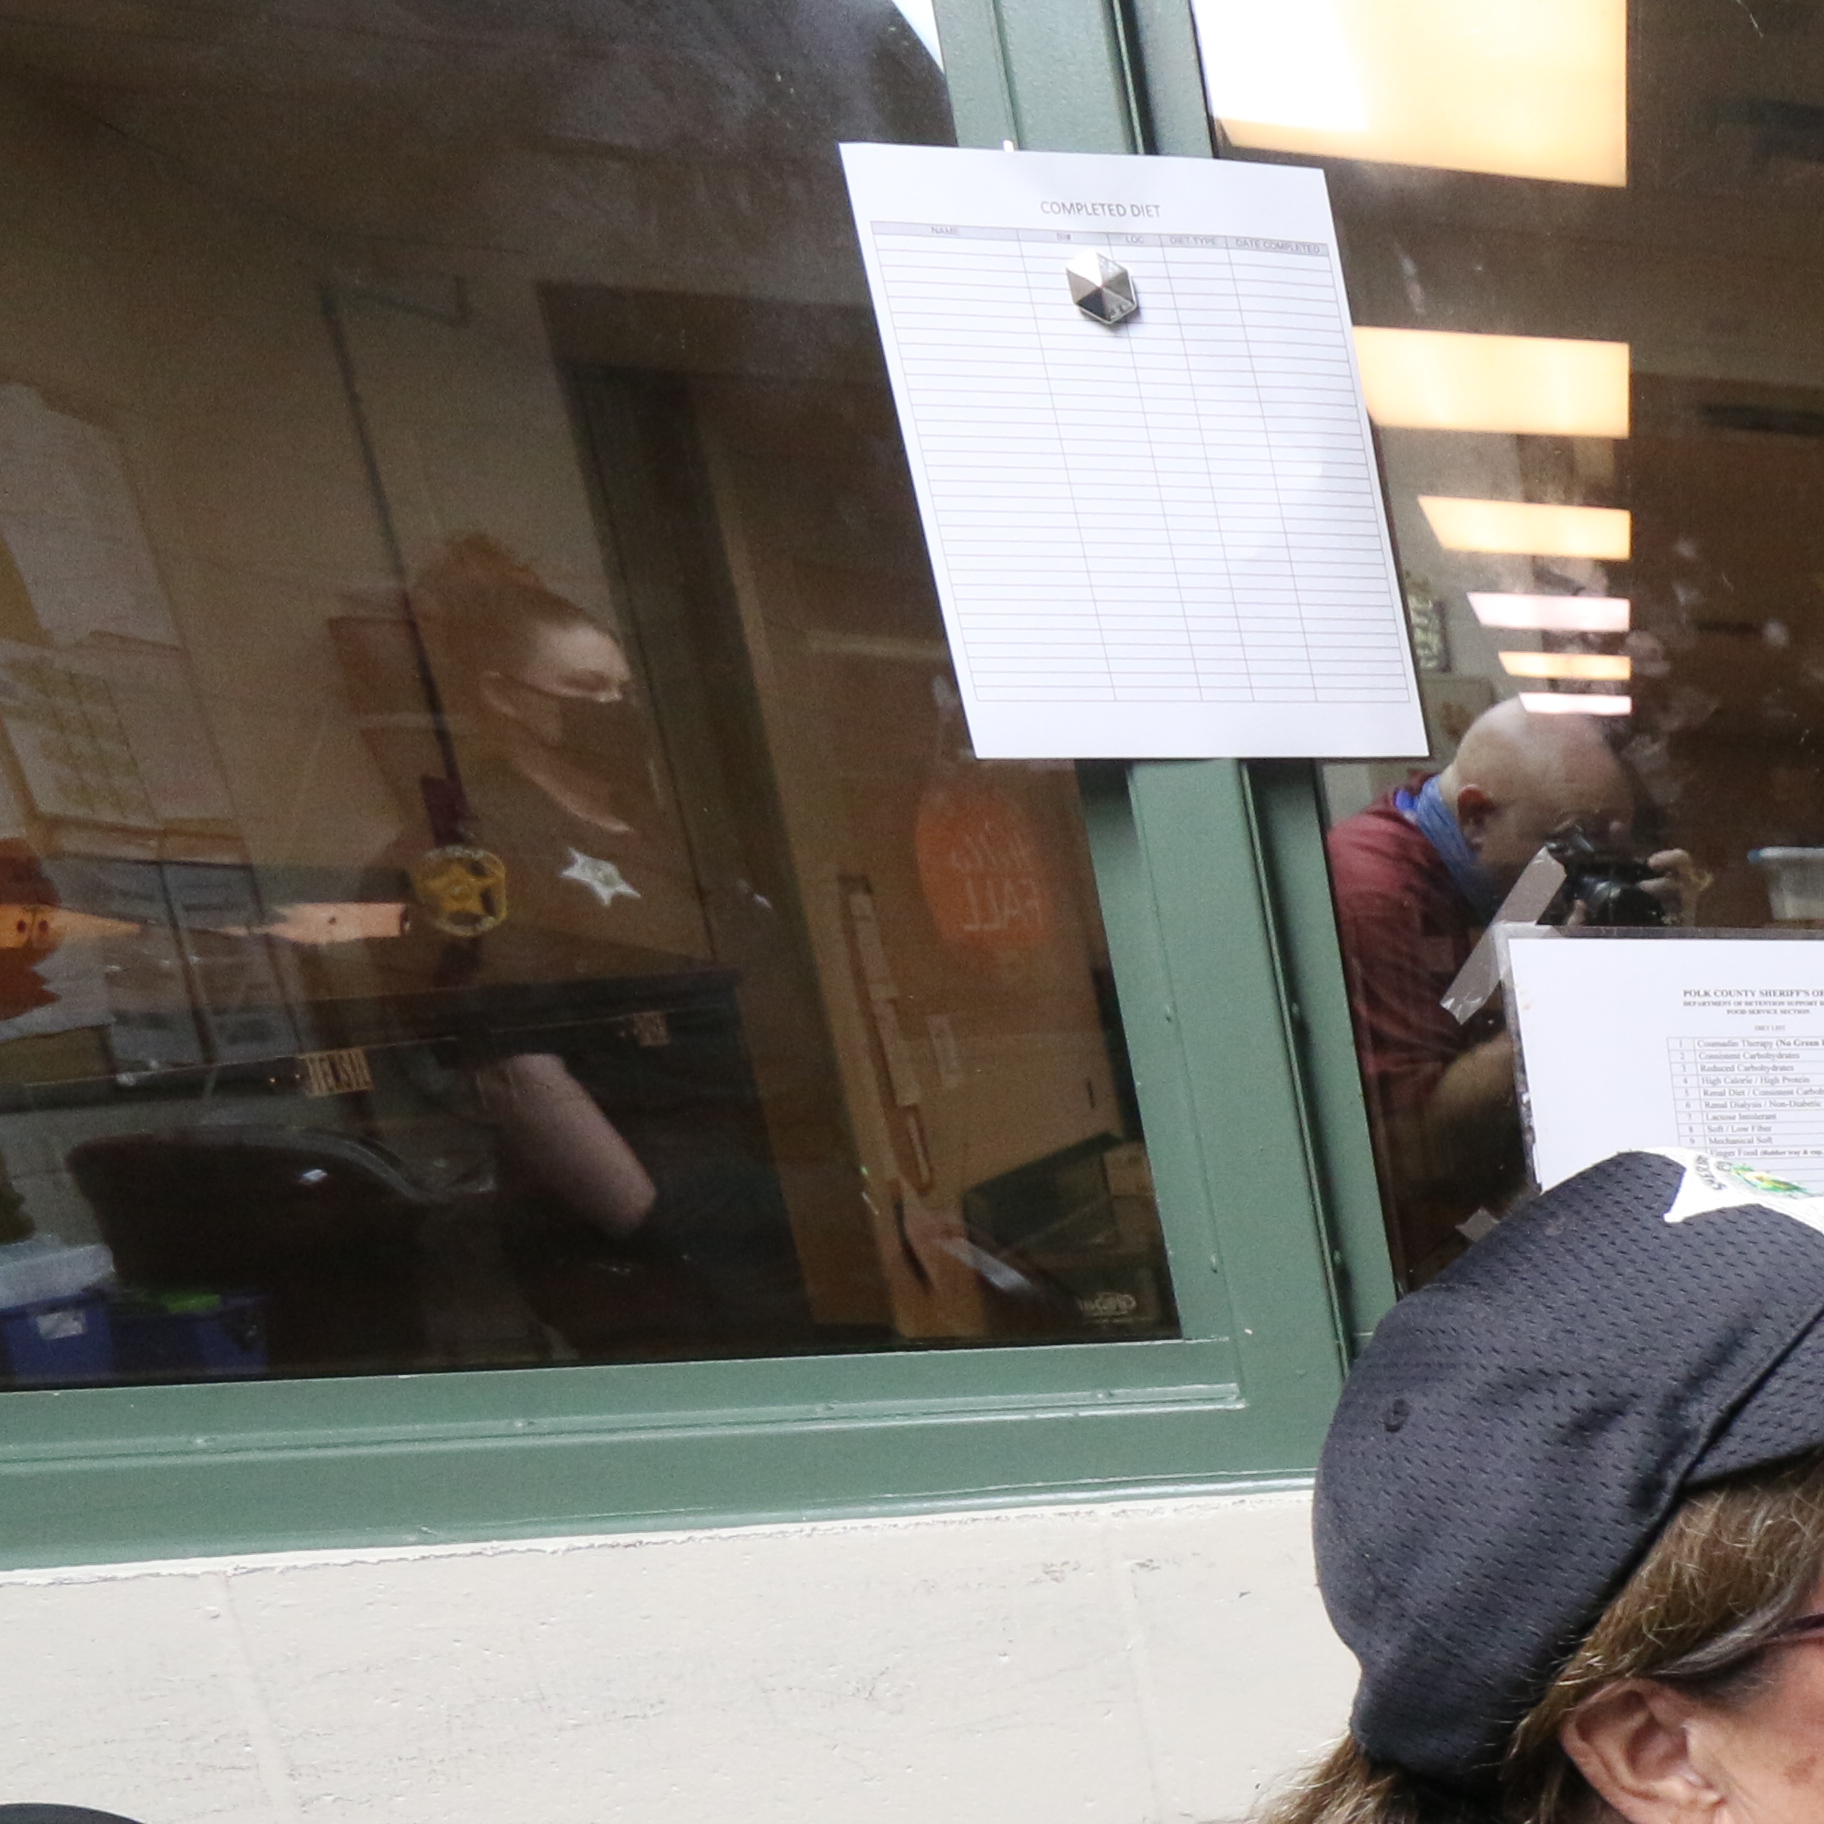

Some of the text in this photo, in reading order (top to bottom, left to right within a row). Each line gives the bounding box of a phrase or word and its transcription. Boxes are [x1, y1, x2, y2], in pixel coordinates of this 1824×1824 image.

[1040, 201, 1162, 217] COMPLETED DIET
[931, 226, 958, 236] NAME
[1125, 235, 1145, 245] LOC
[1170, 237, 1215, 247] DIET TYPE
[1235, 238, 1320, 254] DATE COMPLETED
[1683, 989, 1711, 998] POLK
[1713, 989, 1756, 998] COUNTY
[1759, 989, 1809, 998] SHERIFF'S
[1697, 1039, 1739, 1048] Coumadin
[1742, 1039, 1773, 1050] Therapy
[1775, 1039, 1792, 1048] (No
[1793, 1039, 1820, 1048] Green
[1698, 1052, 1800, 1062] Consistent Carbohydrates
[1700, 1064, 1794, 1073] Reduced Carbohydrates
[1702, 1077, 1722, 1086] High
[1724, 1077, 1752, 1085] Calorie
[1760, 1077, 1780, 1086] High
[1782, 1076, 1810, 1084] Protein
[1703, 1089, 1727, 1097] Renal
[1729, 1088, 1746, 1097] Diet
[1752, 1088, 1794, 1096] Consistent
[1729, 1101, 1762, 1110] Dialysis
[1769, 1100, 1821, 1108] Non-Diabetic
[1706, 1112, 1777, 1121] Lactose Intolerant
[1707, 1124, 1772, 1133] Soft Low Fiber
[1709, 1136, 1773, 1145] Mechanical Soft
[1710, 1149, 1736, 1159] Finger
[1738, 1148, 1759, 1157] Food
